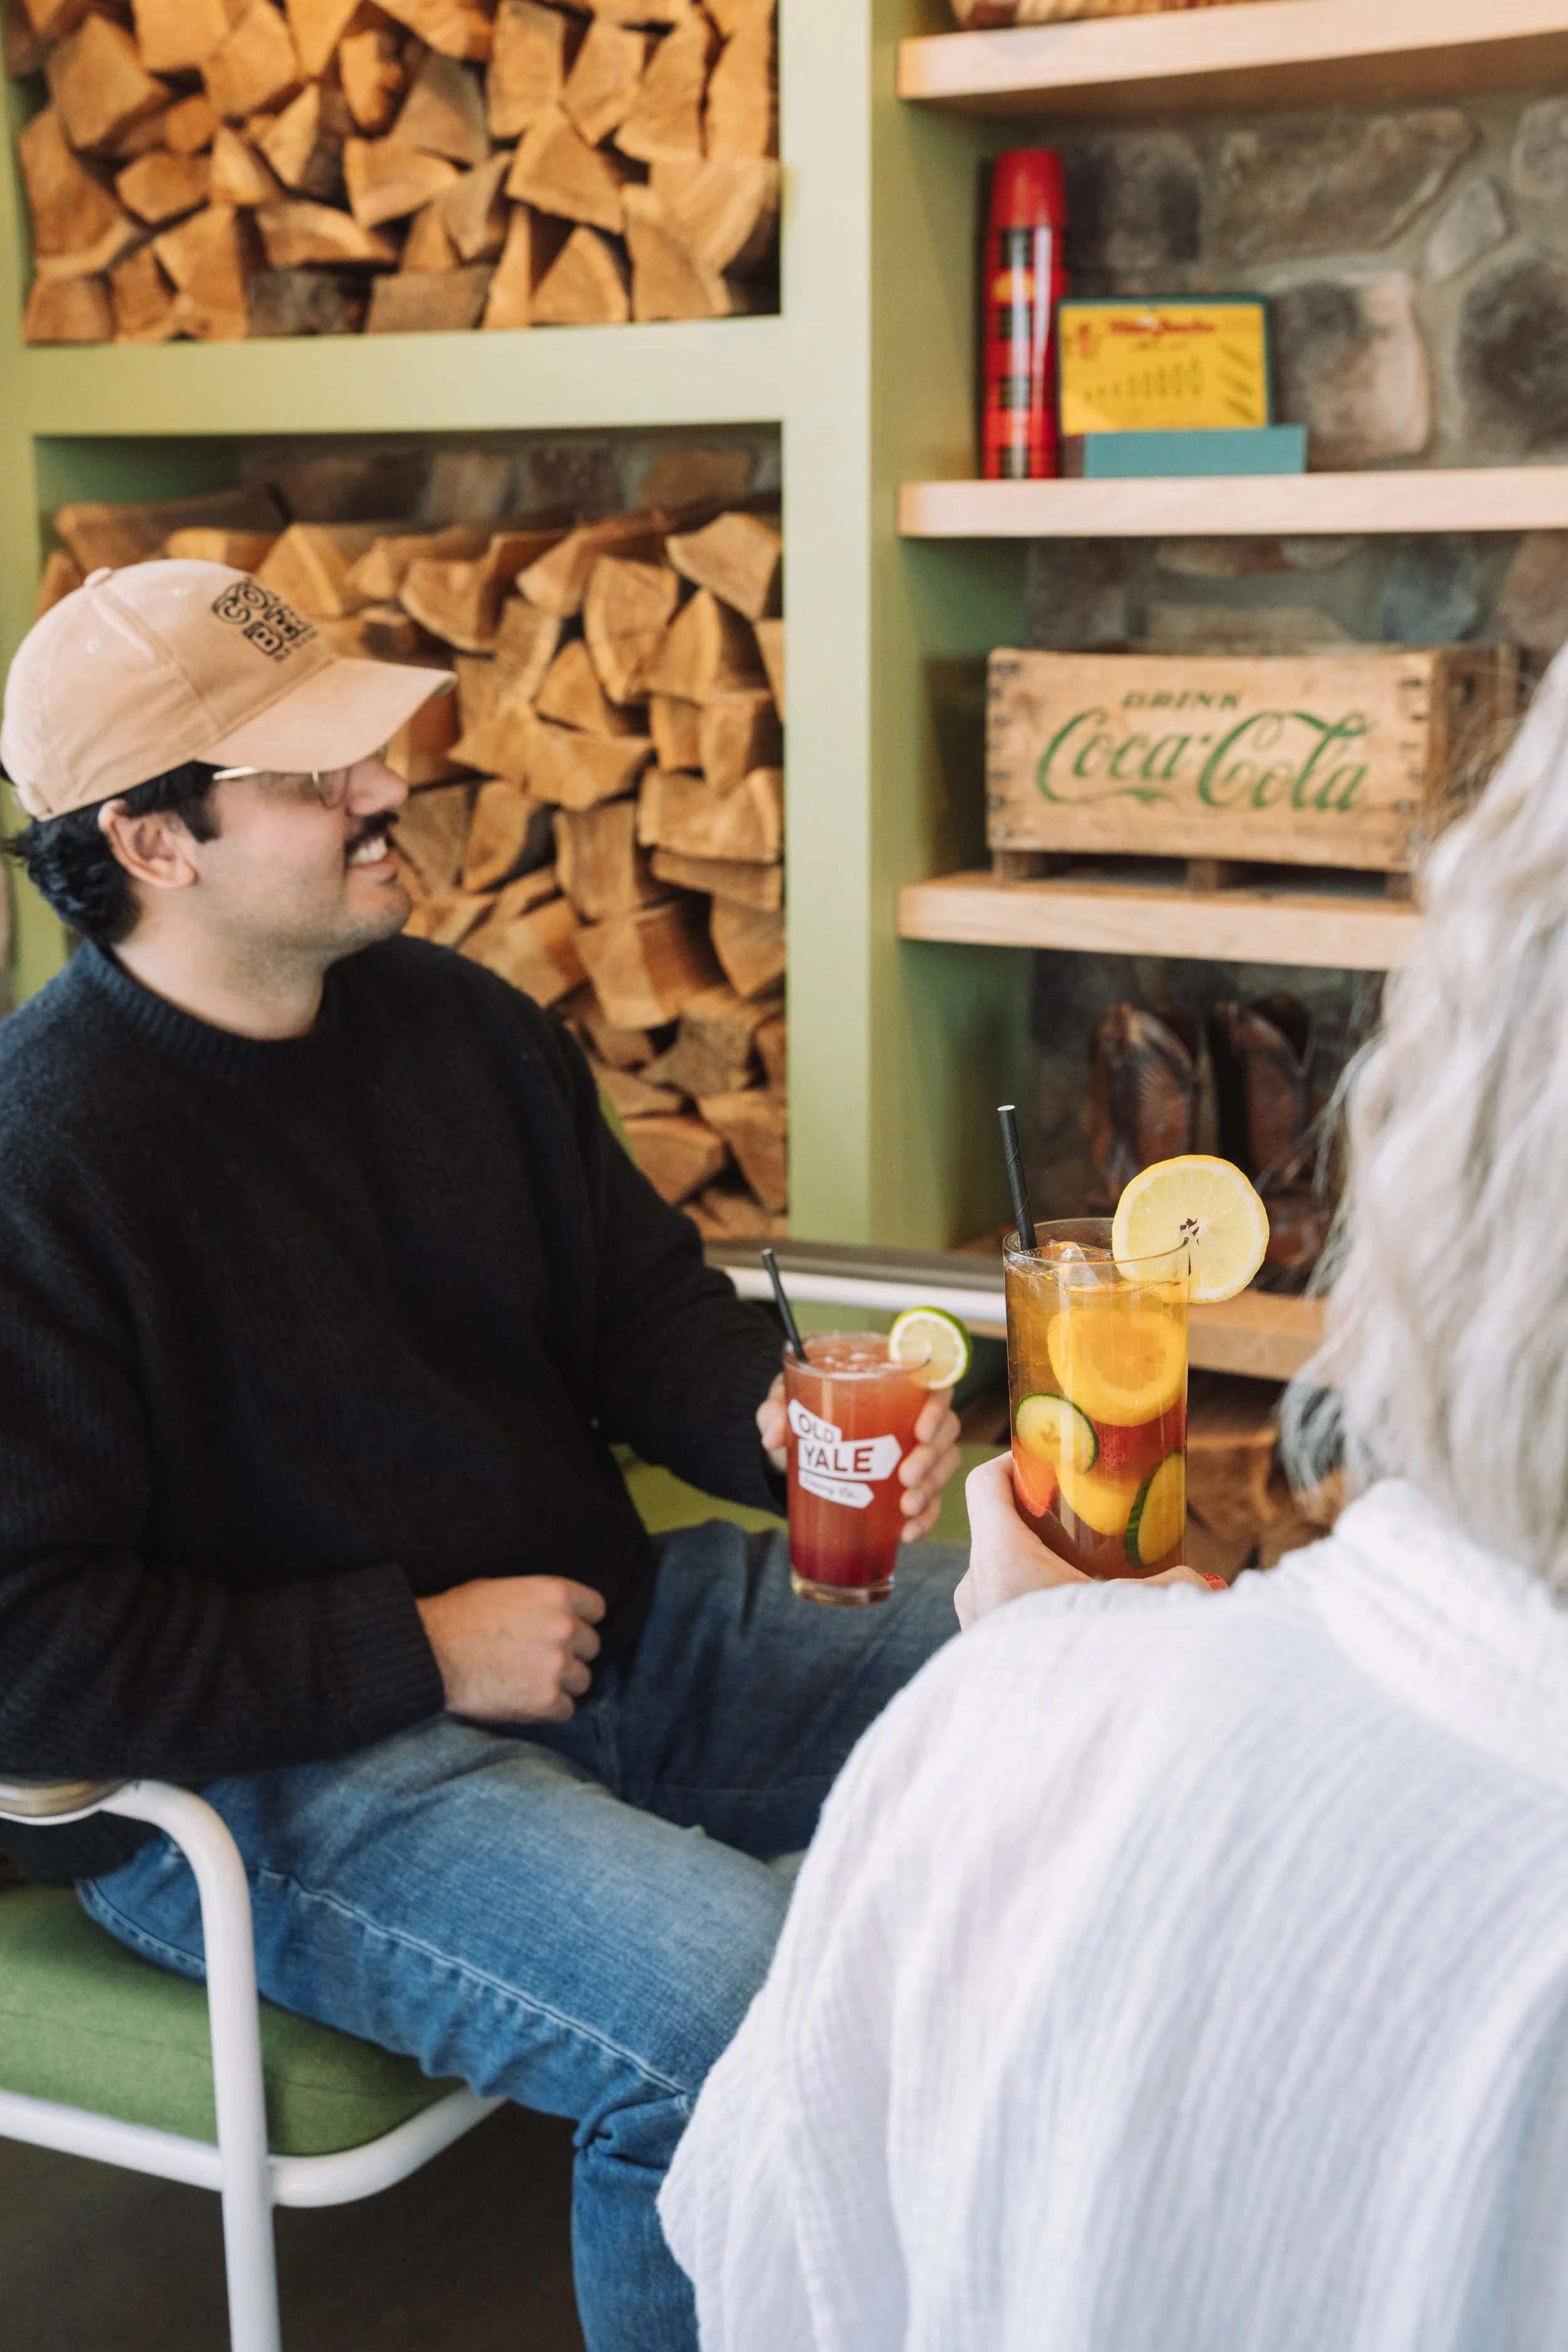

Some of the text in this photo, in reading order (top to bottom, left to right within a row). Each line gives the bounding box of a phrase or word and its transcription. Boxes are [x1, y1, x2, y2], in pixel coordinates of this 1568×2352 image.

[1123, 691, 1242, 709] DRINK
[798, 1414, 834, 1444] OLD
[804, 1446, 874, 1473] YALE
